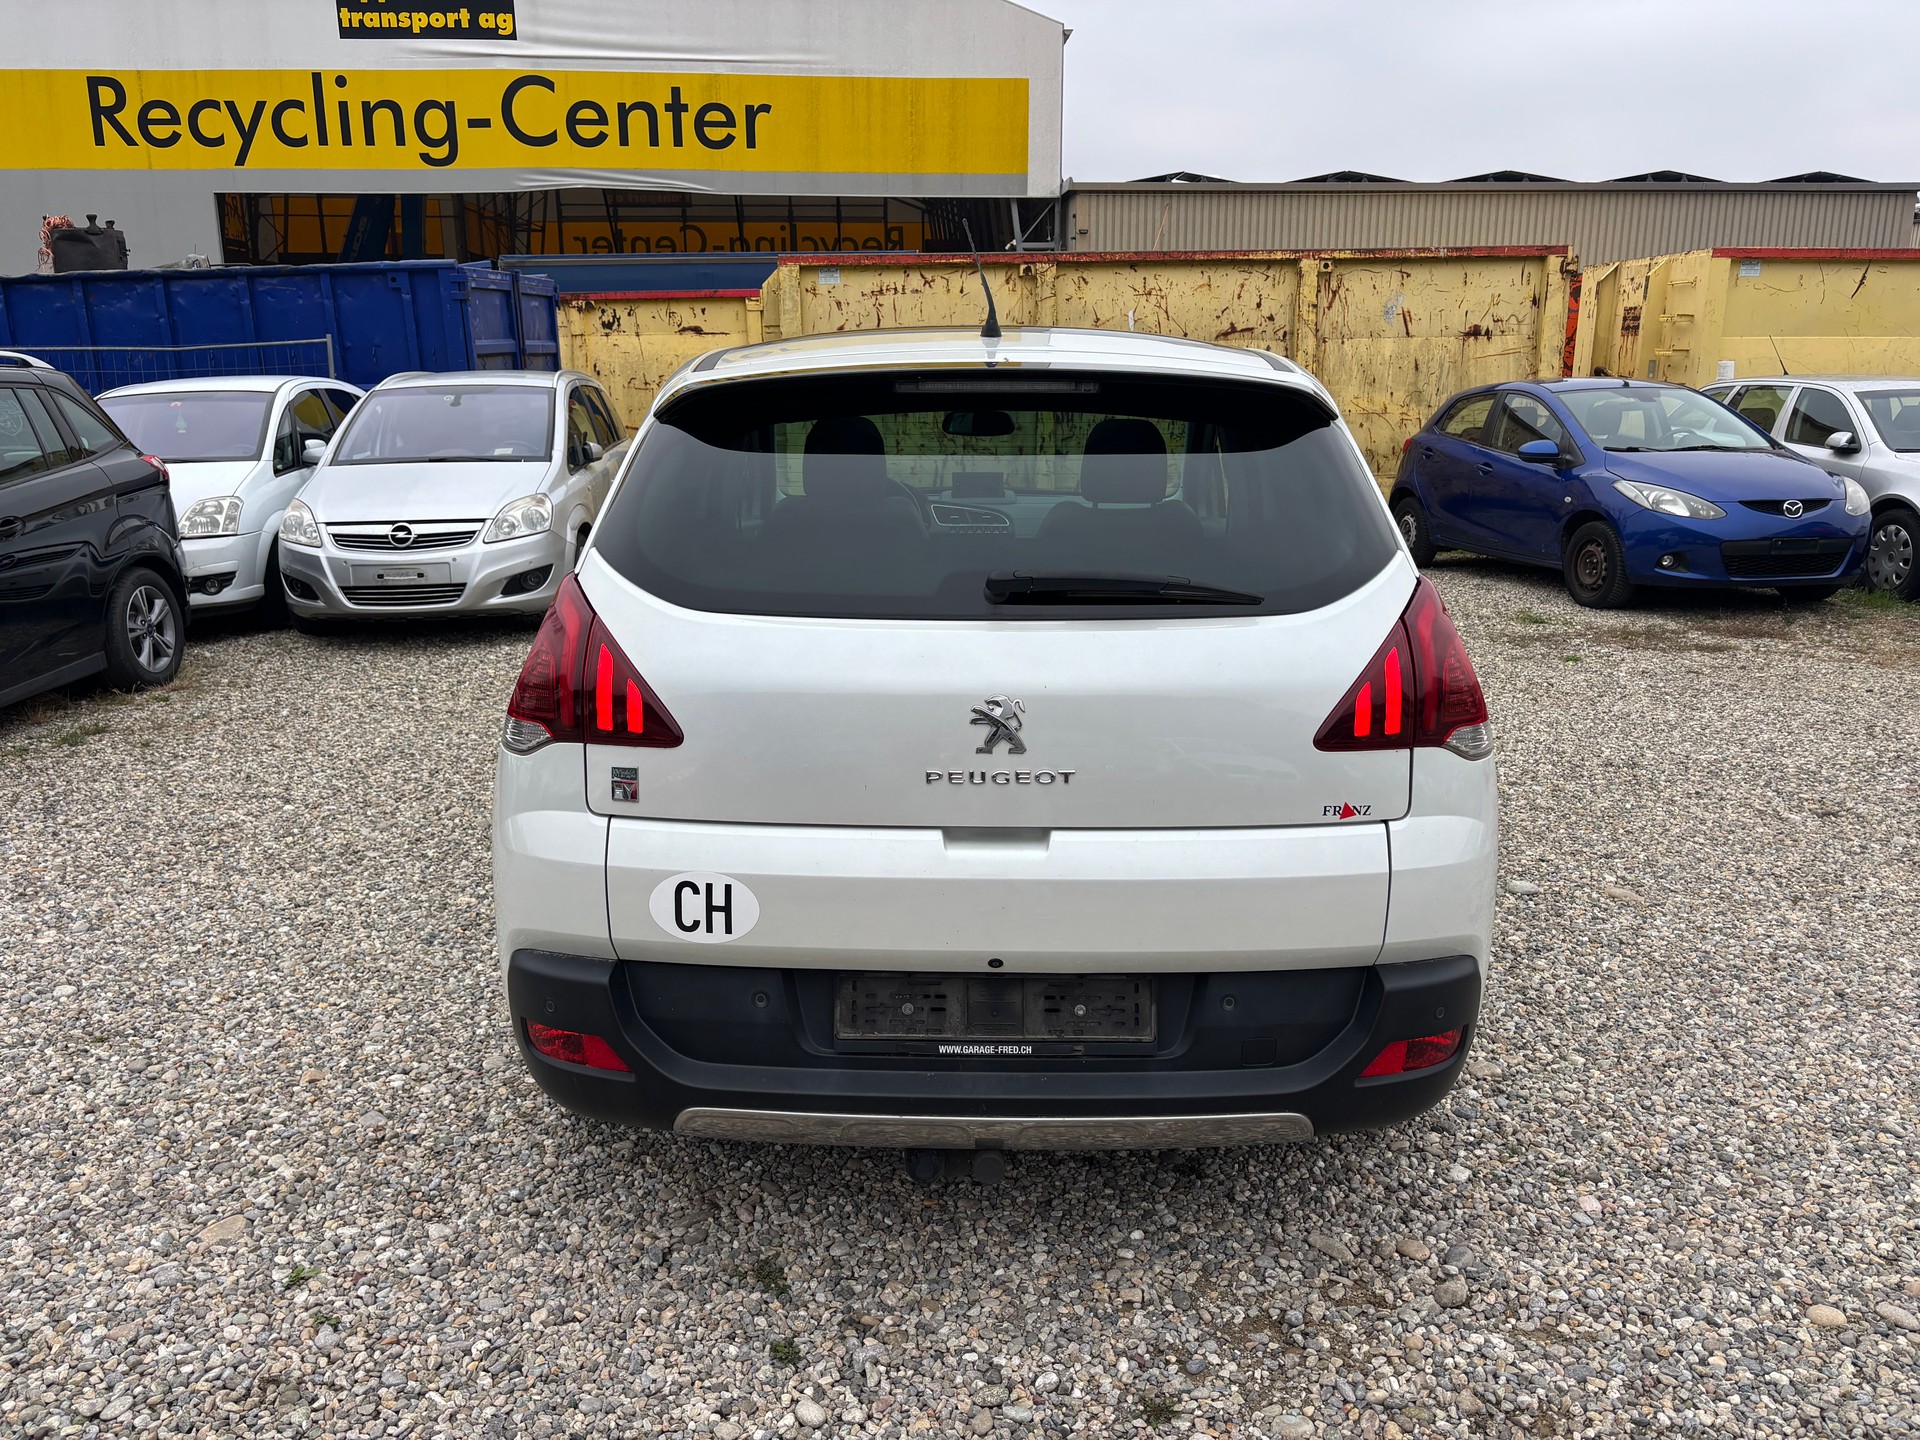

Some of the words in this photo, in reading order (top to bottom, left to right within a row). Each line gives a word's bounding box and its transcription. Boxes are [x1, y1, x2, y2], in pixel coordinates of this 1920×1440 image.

[339, 7, 471, 34] transport
[478, 12, 514, 36] ag
[86, 71, 773, 167] Recycling-Center
[925, 769, 1076, 785] PEUGEOT
[674, 880, 733, 935] CH
[938, 1044, 1033, 1055] WWW.GARAGE-FRED.CH
